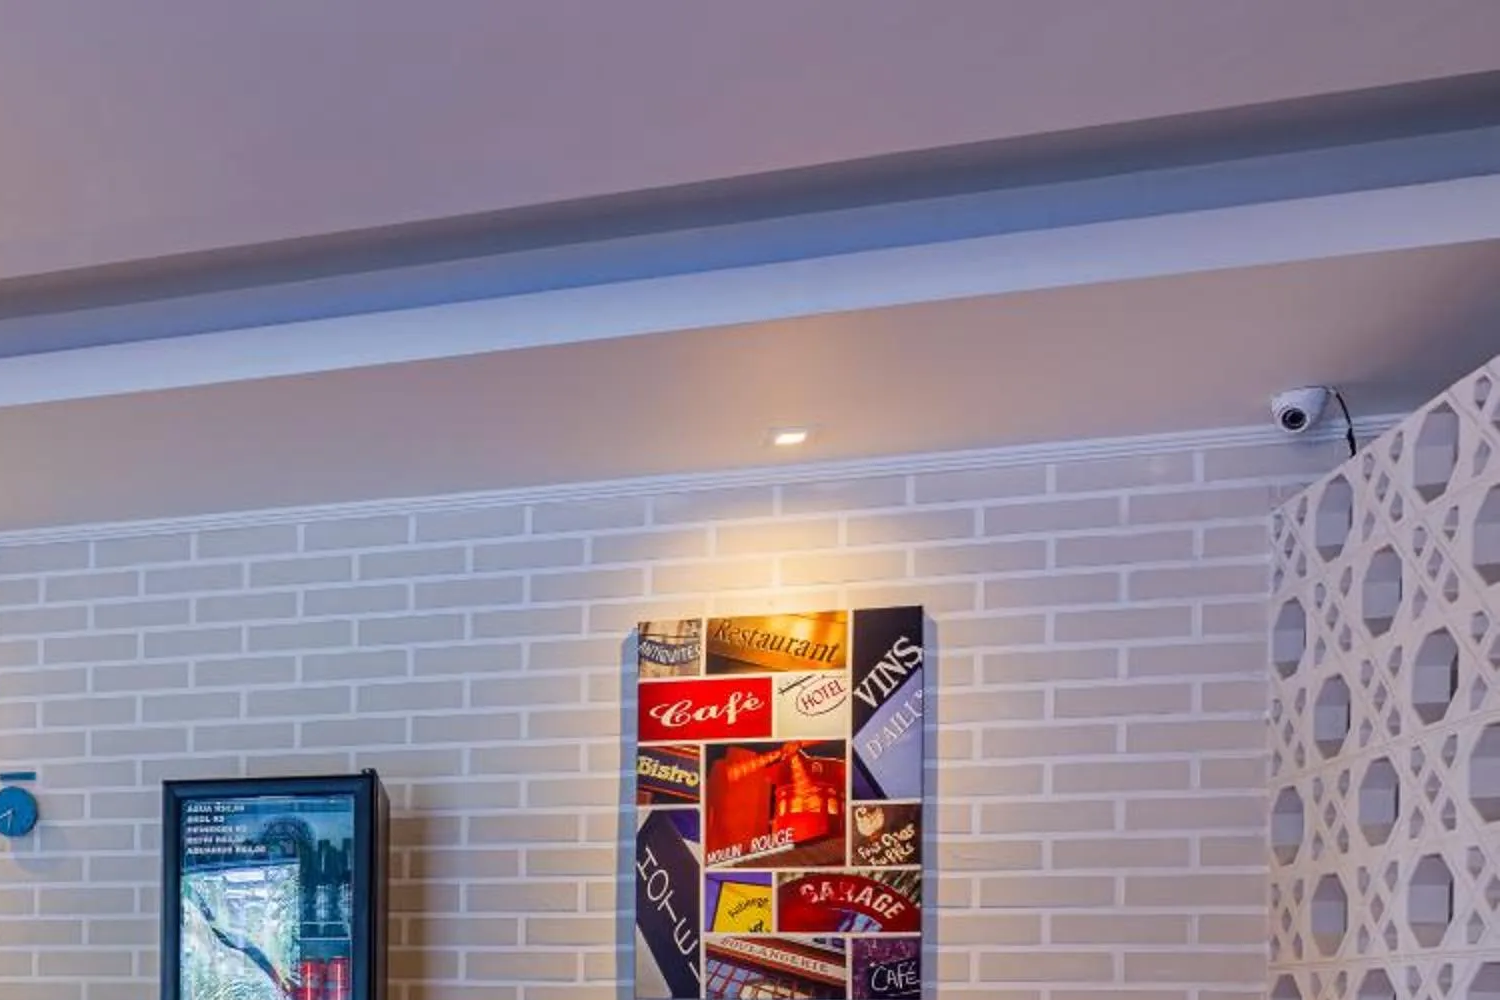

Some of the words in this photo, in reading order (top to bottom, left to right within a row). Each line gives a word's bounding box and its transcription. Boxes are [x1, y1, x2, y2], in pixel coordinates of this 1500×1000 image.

[714, 619, 840, 663] Restaurant
[853, 636, 923, 707] VINS
[649, 691, 765, 727] Café
[801, 679, 845, 710] HOTEL
[637, 756, 700, 787] Bistro
[706, 843, 743, 864] MOULIN
[750, 826, 795, 853] ROUGE
